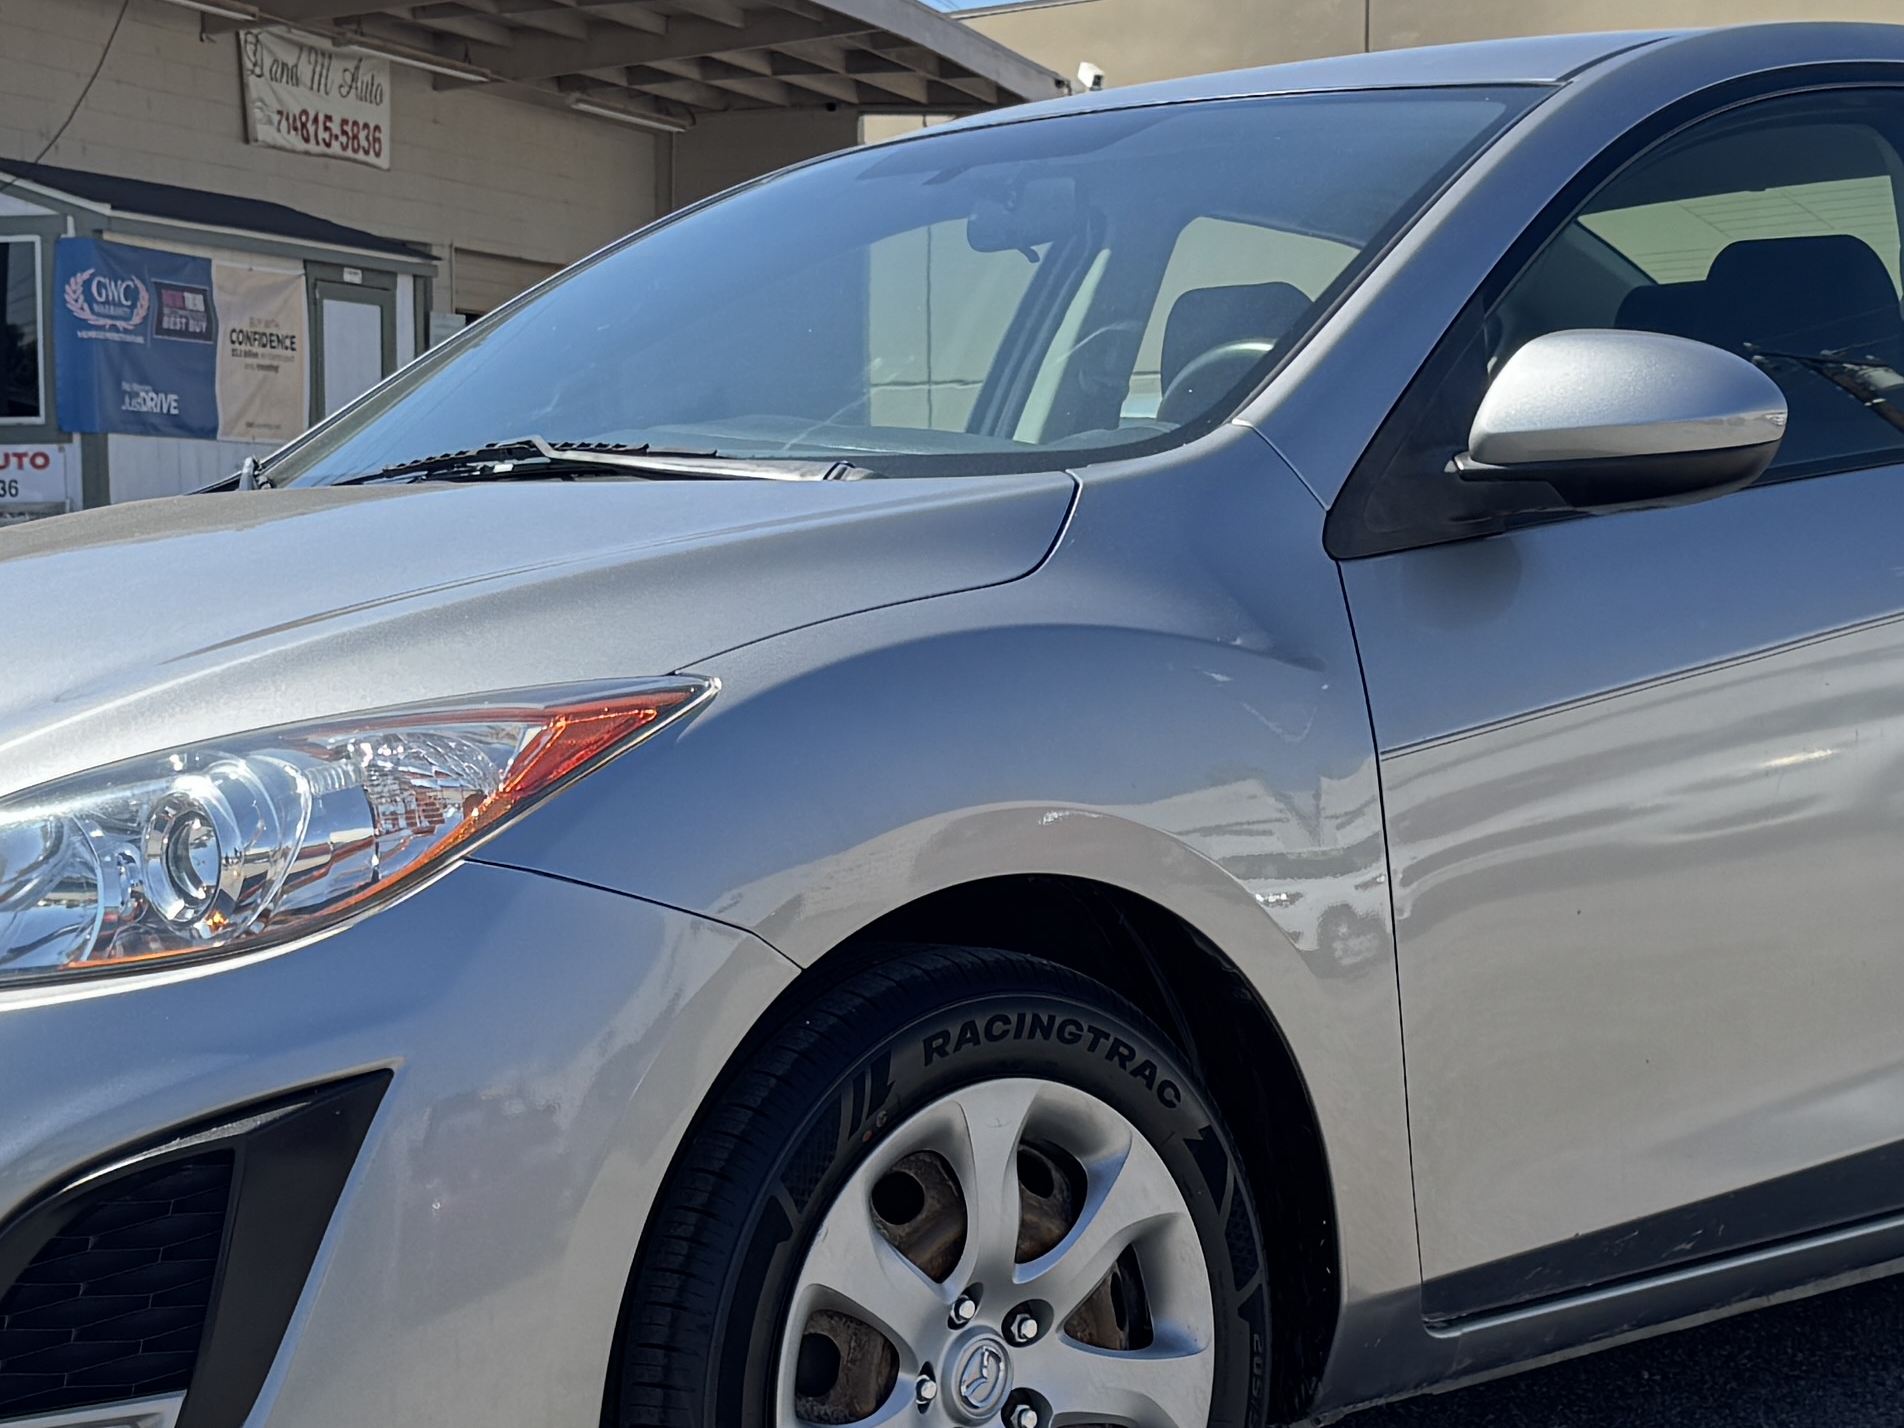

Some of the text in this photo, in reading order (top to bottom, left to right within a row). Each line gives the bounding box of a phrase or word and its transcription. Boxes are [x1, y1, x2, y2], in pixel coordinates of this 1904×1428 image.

[269, 46, 304, 87] and
[308, 46, 335, 96] M
[339, 57, 384, 106] Auto
[90, 275, 135, 306] GWC
[229, 328, 297, 352] CONFIDENCE
[921, 1011, 1183, 1110] RACINGTRAC
